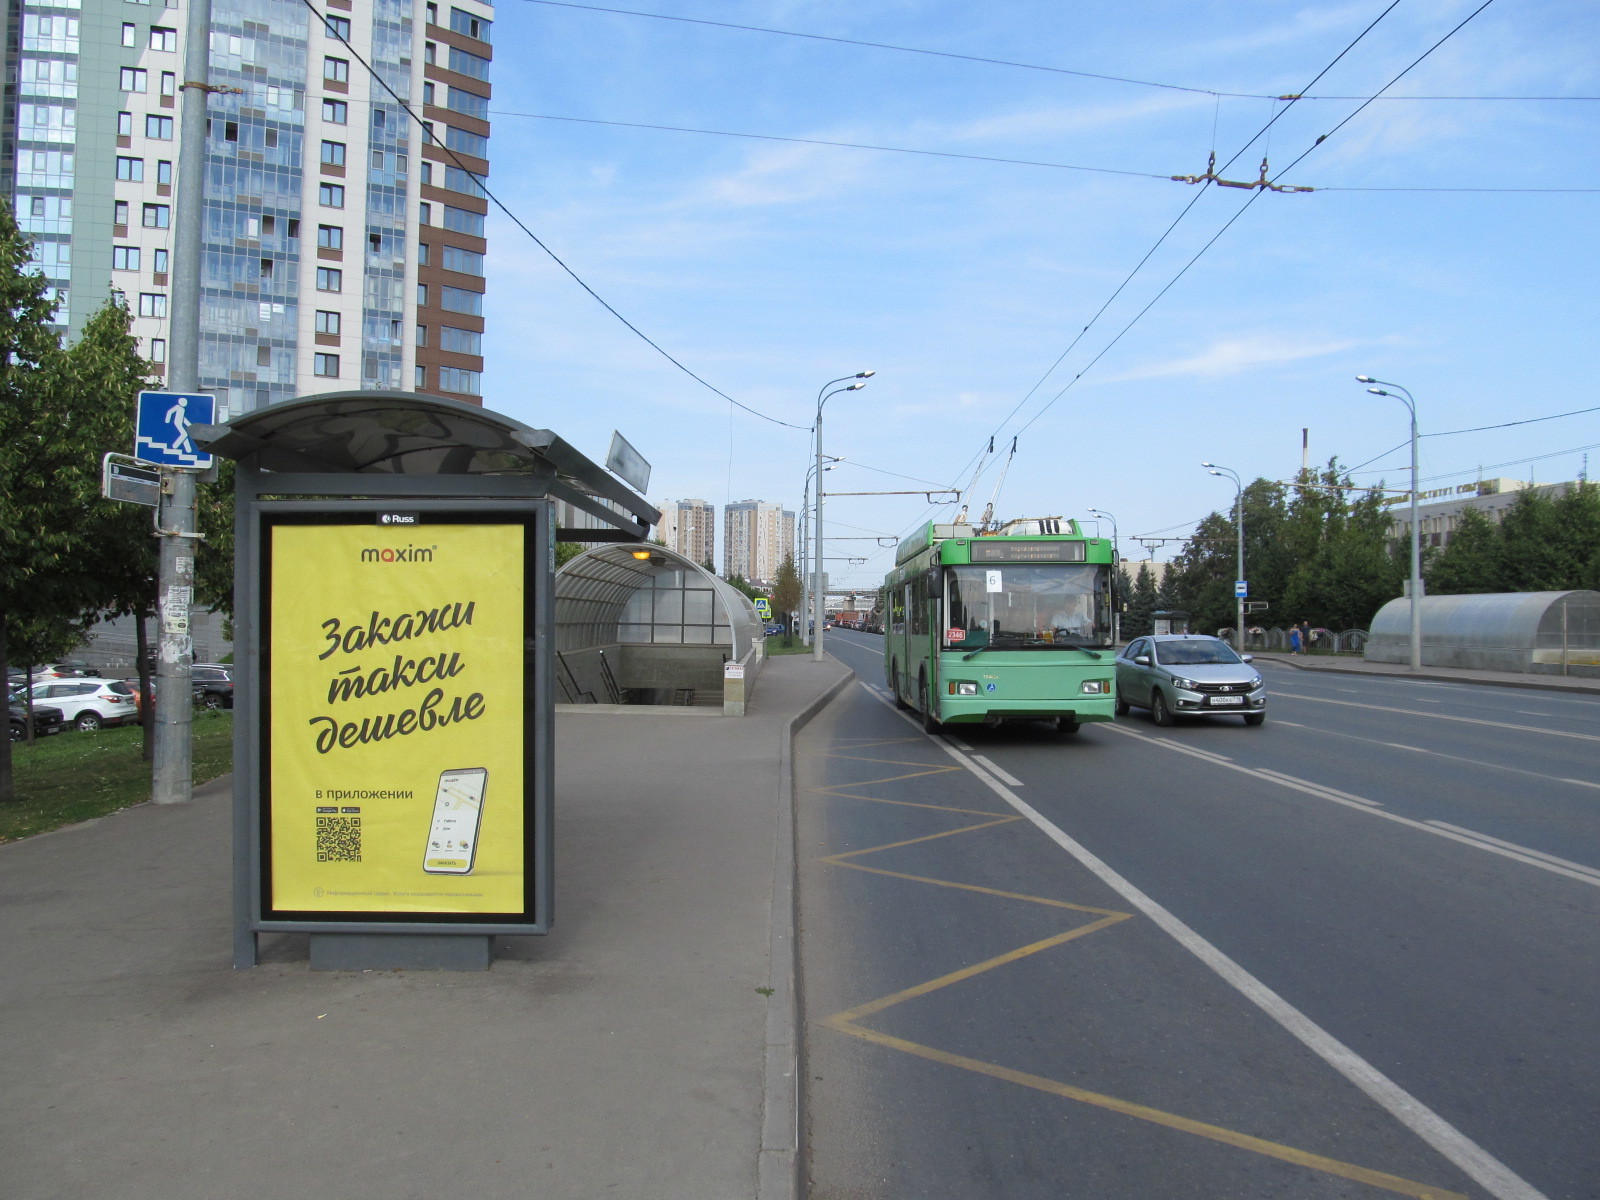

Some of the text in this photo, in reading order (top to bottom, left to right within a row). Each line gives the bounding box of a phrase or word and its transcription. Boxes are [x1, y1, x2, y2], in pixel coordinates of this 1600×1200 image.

[392, 514, 414, 523] Russ
[989, 575, 996, 585] 6
[318, 601, 476, 661] Закажи
[327, 652, 465, 705] такси
[308, 687, 486, 754] дешевле
[316, 790, 413, 801] в приложении
